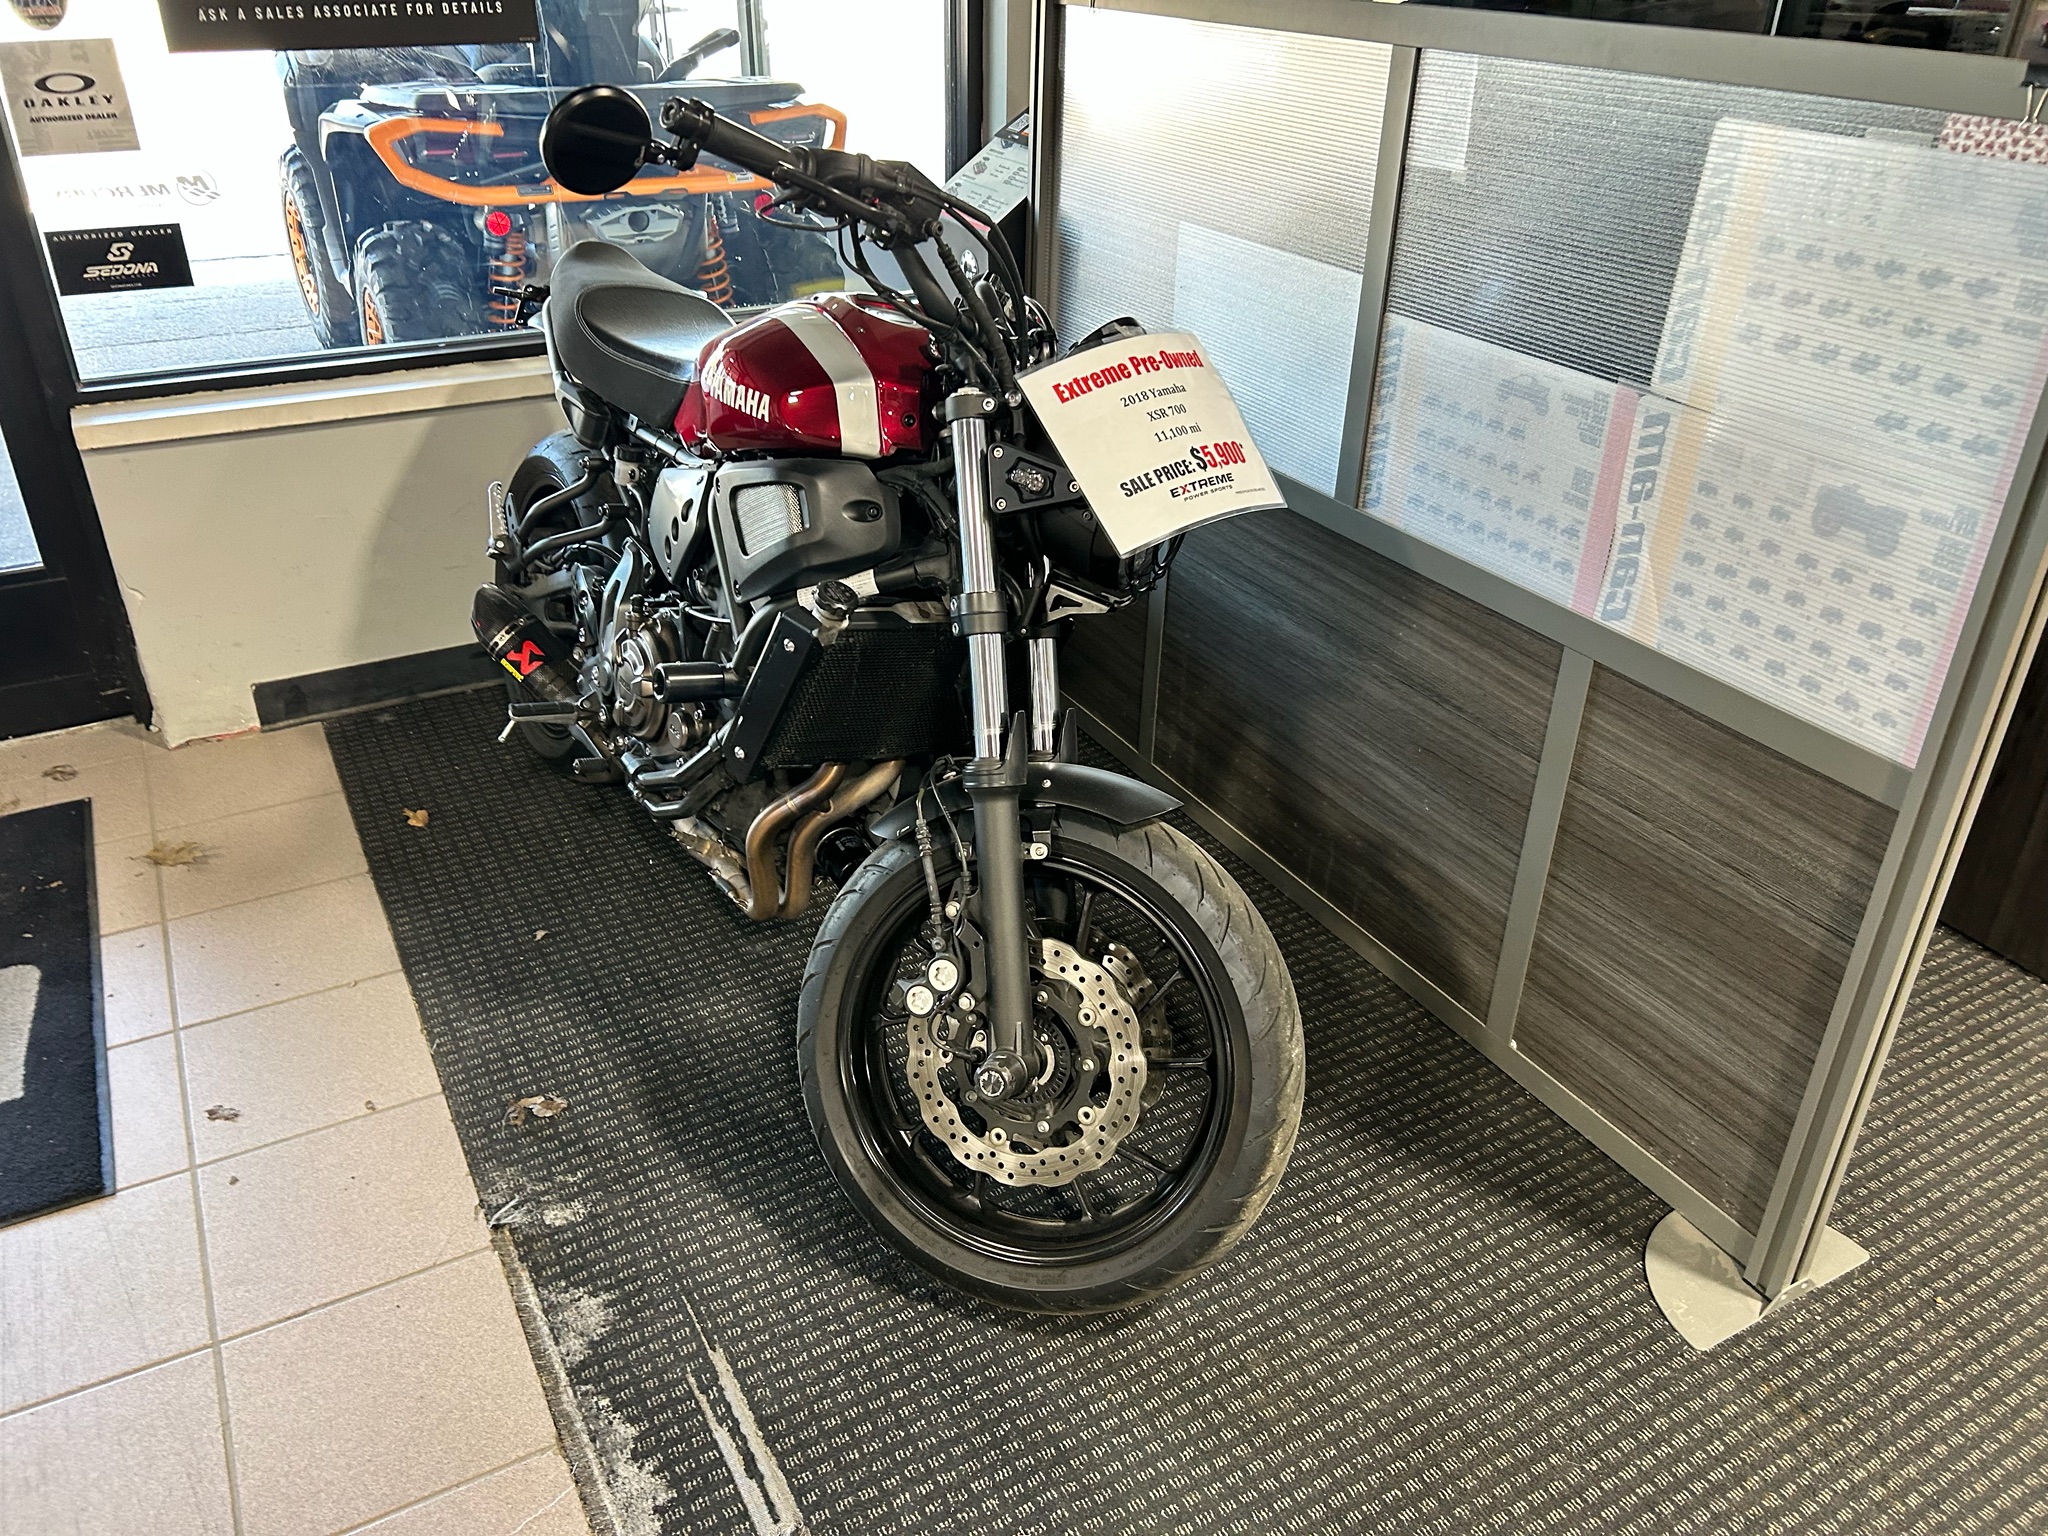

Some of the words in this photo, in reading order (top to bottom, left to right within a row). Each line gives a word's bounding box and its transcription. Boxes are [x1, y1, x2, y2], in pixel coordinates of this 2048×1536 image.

[198, 6, 228, 22] ASK
[237, 7, 246, 21] A
[254, 5, 304, 20] SALES
[313, 3, 398, 19] ASSOCIATE
[406, 2, 434, 16] FOR
[442, 1, 503, 15] DETAILS
[24, 95, 113, 108] OAKLEY
[30, 114, 83, 123] AUTHORIZED
[85, 112, 118, 121] DEALER
[52, 231, 124, 242] AUTHORIZED
[130, 228, 173, 237] DEALER
[83, 262, 159, 278] SEDONA
[1052, 362, 1132, 404] Extreme
[1128, 350, 1204, 375] Pre-Owned
[705, 364, 770, 423] YAMAHA
[1120, 390, 1150, 408] 2018
[1149, 383, 1187, 399] Yamaha
[1146, 407, 1169, 422] XSR
[1168, 403, 1187, 416] 700
[1154, 425, 1189, 443] 11,100
[1189, 422, 1202, 434] mi
[1119, 472, 1156, 498] SALE
[1153, 459, 1196, 485] PRICE:
[1169, 472, 1234, 498] EXTREME
[1183, 490, 1209, 502] POWER
[1210, 484, 1233, 494] SPORTS
